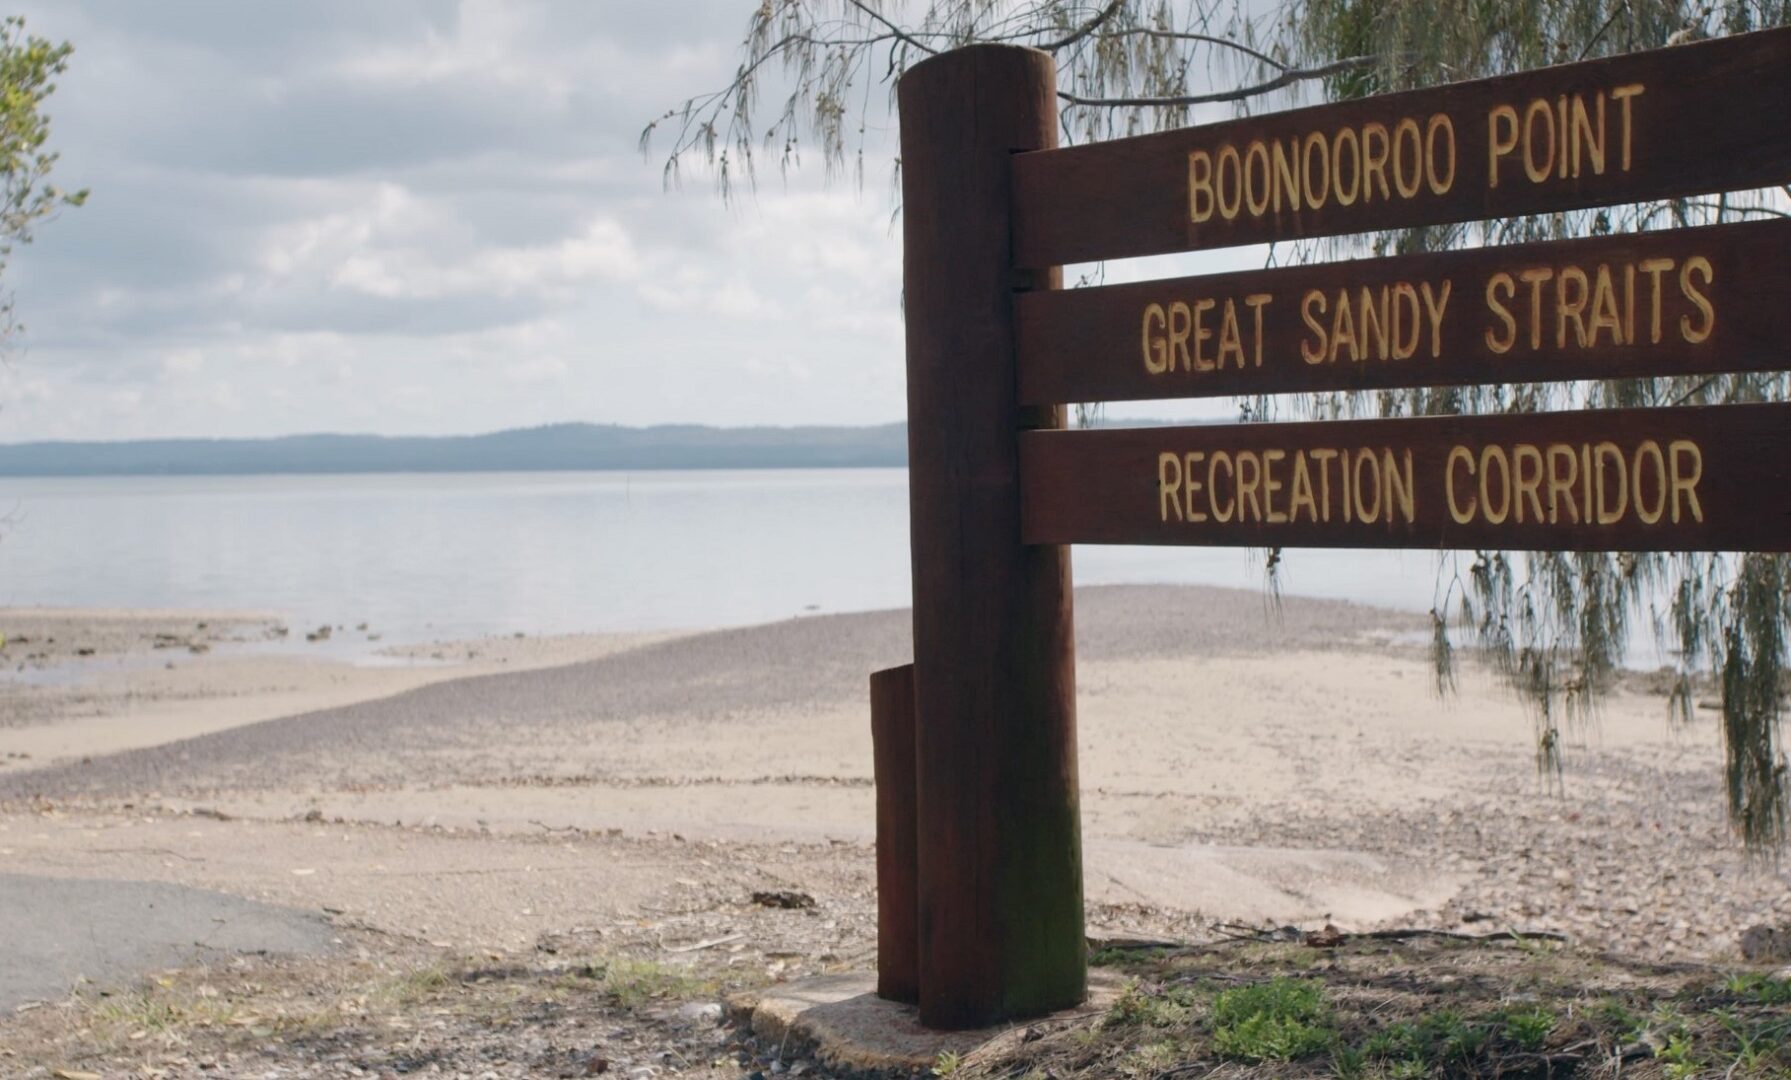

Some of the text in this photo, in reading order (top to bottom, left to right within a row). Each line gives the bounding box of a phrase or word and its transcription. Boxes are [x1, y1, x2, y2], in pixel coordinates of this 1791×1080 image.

[1188, 84, 1645, 224] BOONOOROO POINT
[1142, 256, 1715, 374] GREAT SANDY STRAITS
[1158, 440, 1704, 526] RECREATION CORRIDOR
